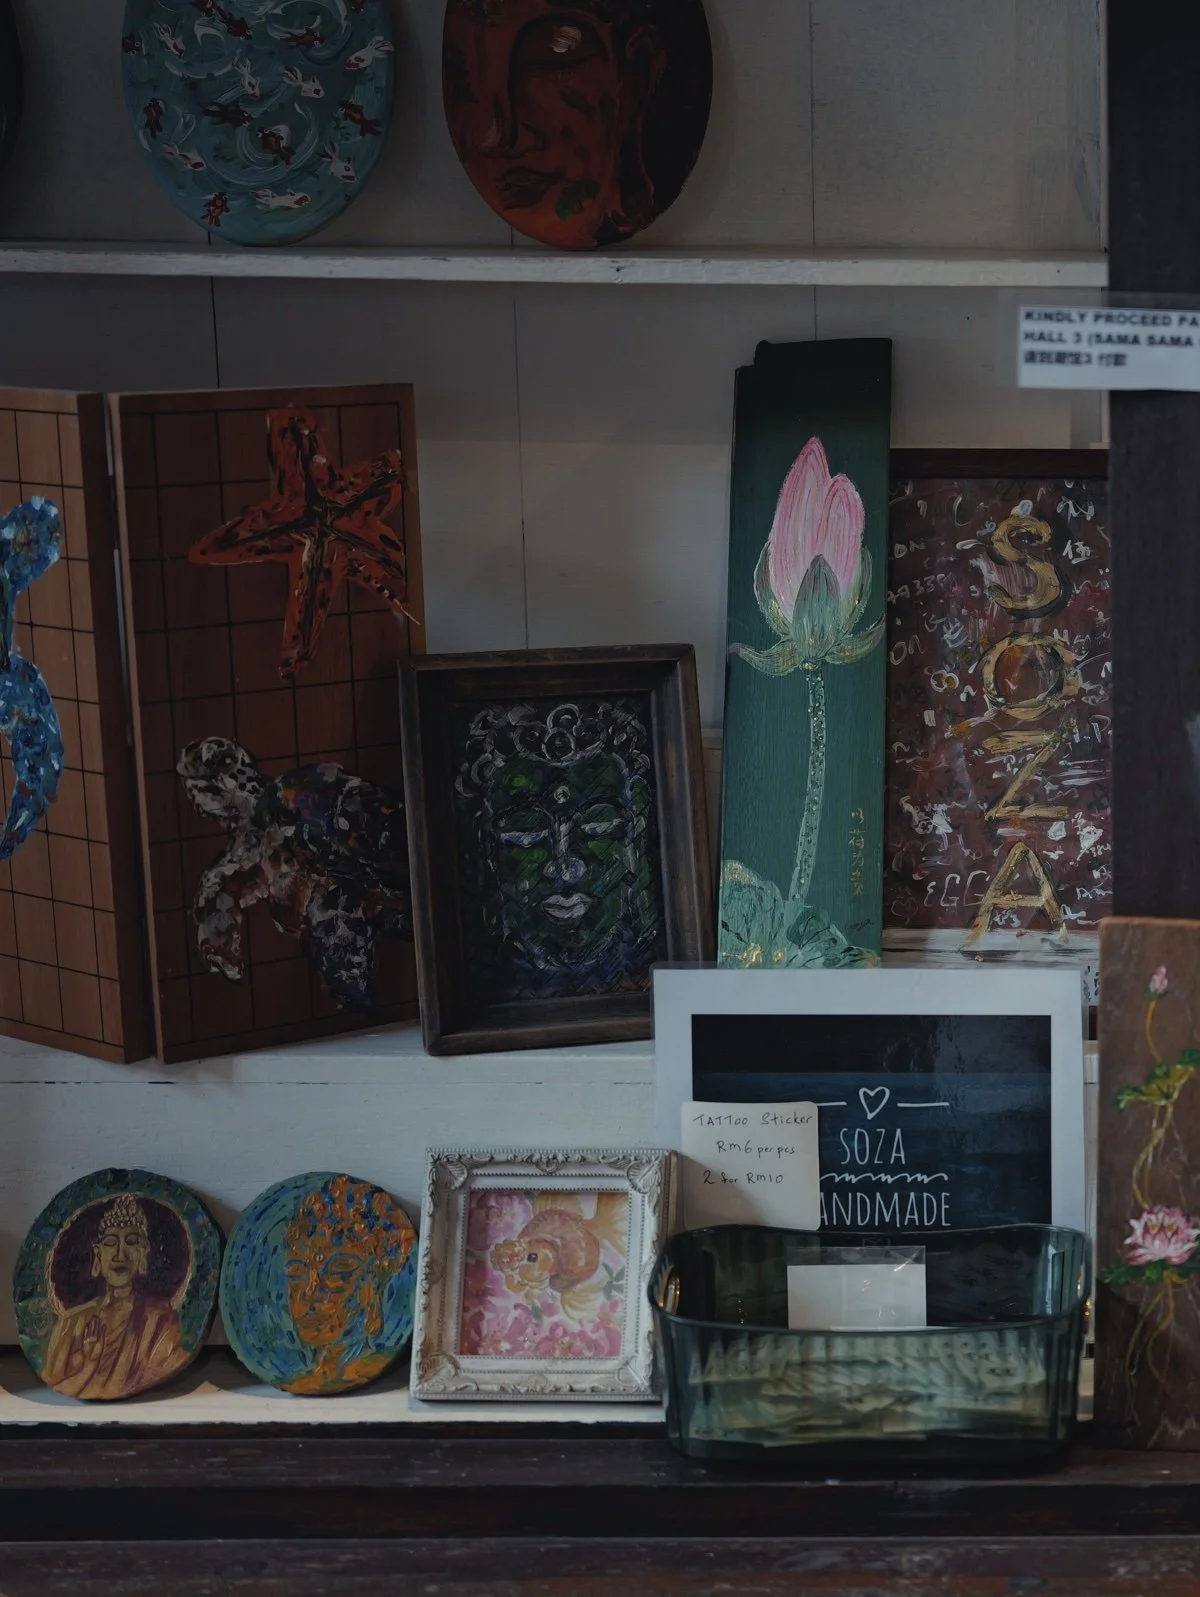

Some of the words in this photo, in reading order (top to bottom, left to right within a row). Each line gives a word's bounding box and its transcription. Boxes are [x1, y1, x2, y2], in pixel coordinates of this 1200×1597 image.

[1024, 310, 1087, 325] KINDLY
[1093, 312, 1171, 328] PROCEED
[1024, 331, 1066, 344] HALL
[1088, 332, 1141, 347] (SAMA
[1146, 335, 1193, 348] SAMA
[761, 1111, 815, 1126] Sticker
[840, 1127, 905, 1166] SOZA
[703, 1169, 715, 1185] 2
[720, 1171, 739, 1185] for
[819, 1191, 951, 1228] ANDMADE
